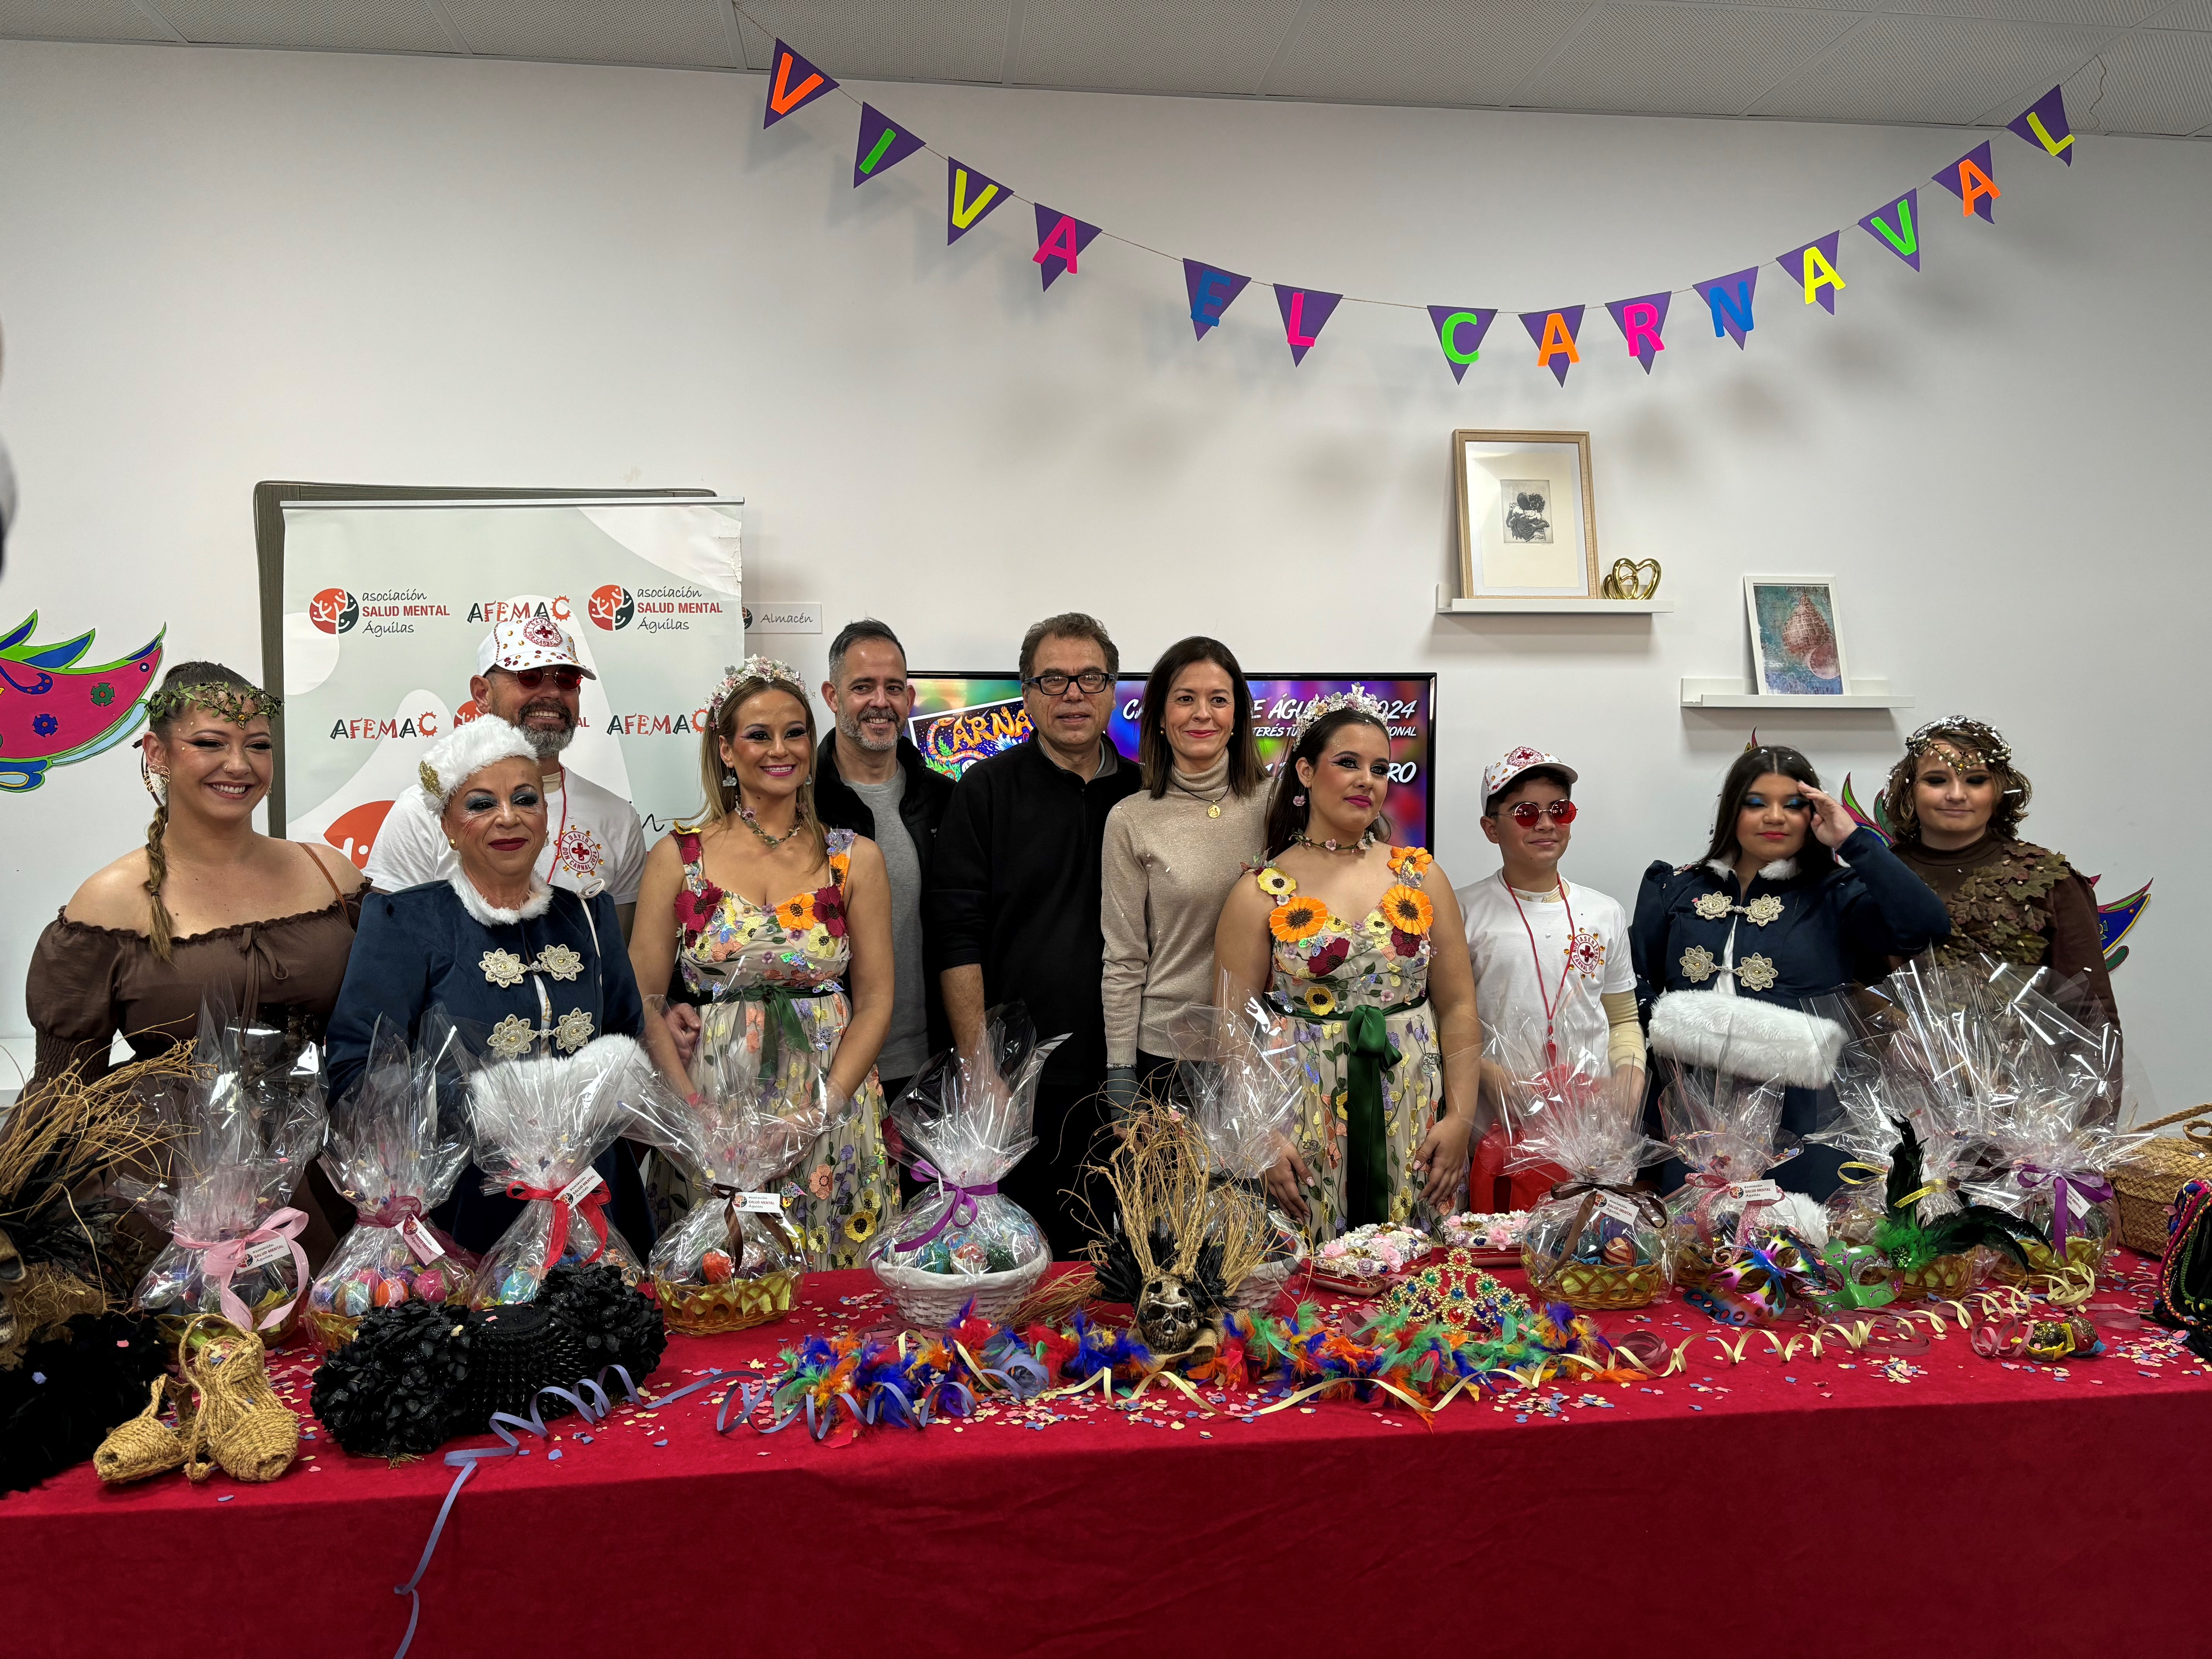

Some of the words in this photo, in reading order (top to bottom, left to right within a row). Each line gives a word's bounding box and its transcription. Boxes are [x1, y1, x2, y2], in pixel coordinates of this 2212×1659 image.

[770, 52, 1078, 274] VIVA
[1190, 270, 1315, 347] EL
[1441, 112, 2075, 367] CARNAVAL
[362, 606, 399, 617] SALUD
[403, 605, 450, 617] MENTAL
[467, 595, 571, 623] AFEMAC
[637, 602, 675, 613] SALUD
[678, 602, 723, 613] MENTAL
[760, 613, 813, 623] Almacén
[362, 620, 414, 637] Águilas
[637, 617, 689, 634] Águilas
[330, 711, 438, 740] AFEMAC
[568, 833, 589, 843] DAVID
[562, 847, 570, 860] DON
[569, 860, 591, 871] CARNAL
[1580, 936, 1595, 945] ASEN
[1573, 955, 1587, 971] CARNAL
[1619, 1208, 1633, 1217] MENTAL
[268, 1245, 284, 1254] MENTAL
